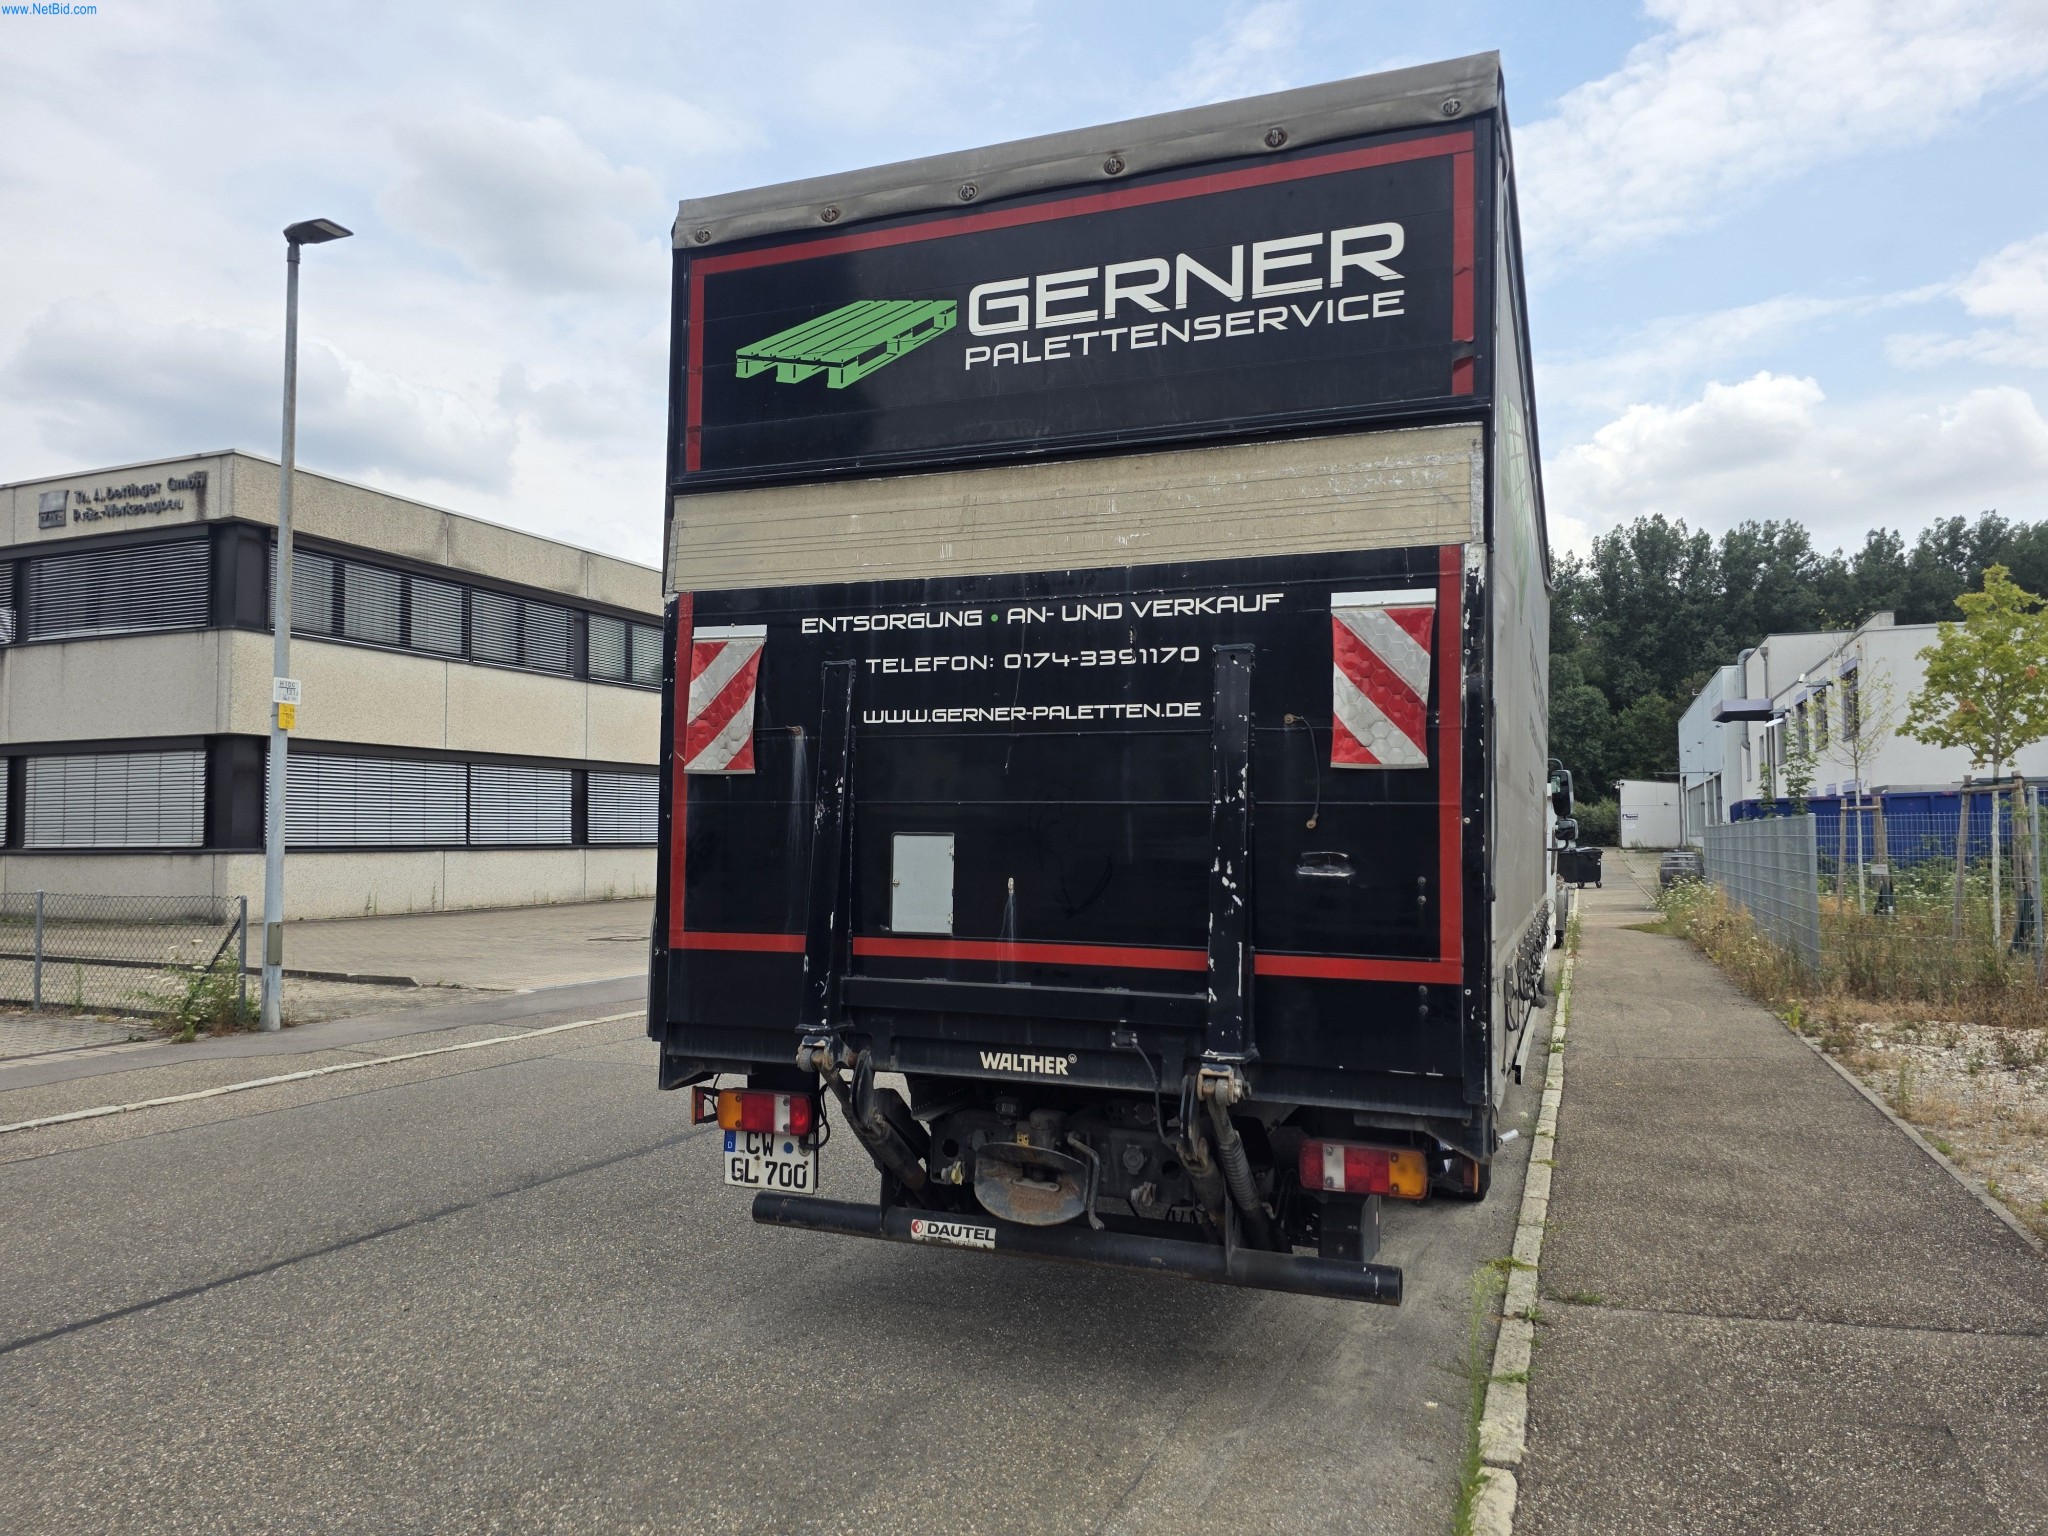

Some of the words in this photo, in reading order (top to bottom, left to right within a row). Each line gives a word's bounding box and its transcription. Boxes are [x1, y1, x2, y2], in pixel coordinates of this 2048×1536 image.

[968, 221, 1405, 337] GERNER
[965, 289, 1405, 371] PALETTENSERVICE
[801, 609, 983, 634] ENTSORGUNG
[1007, 606, 1054, 625] AN-
[1061, 602, 1123, 622] UND
[1130, 593, 1284, 618] VERKAUF
[865, 654, 994, 674] TELEFON:
[863, 702, 1202, 724] WWW.GERNER-PALETTEN.DE
[980, 1051, 1069, 1076] WALTHER
[746, 1132, 774, 1157] CW
[731, 1157, 759, 1184] GL
[765, 1161, 807, 1189] 700
[927, 1222, 995, 1242] DAUTEL
